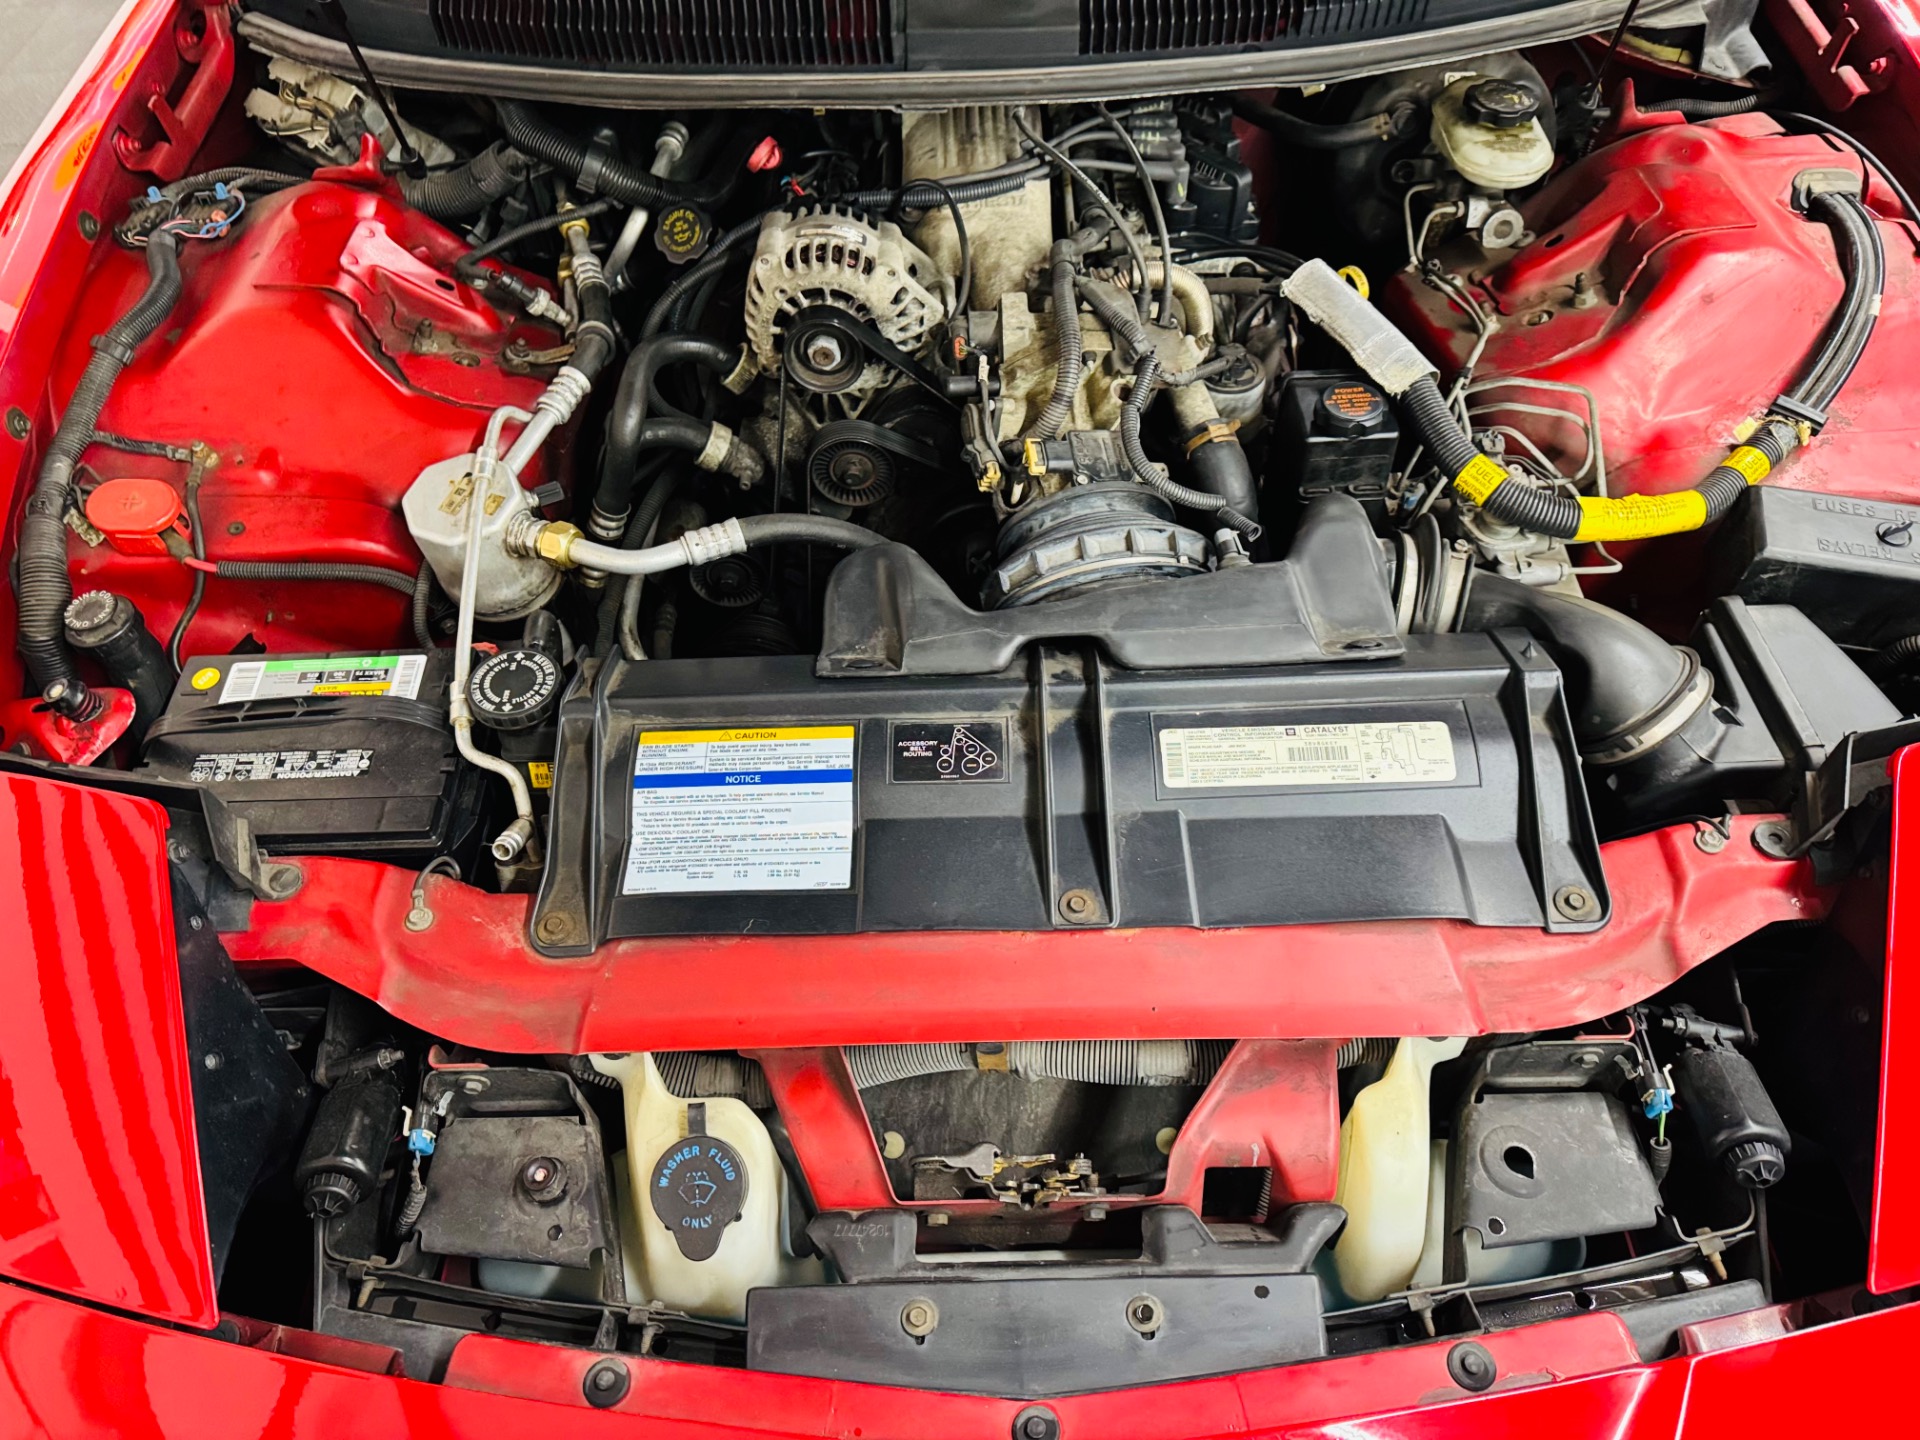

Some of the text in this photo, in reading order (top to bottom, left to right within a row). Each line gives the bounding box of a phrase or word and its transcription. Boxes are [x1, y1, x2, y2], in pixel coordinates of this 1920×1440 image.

[1478, 456, 1503, 477] CAUTION
[1742, 455, 1763, 473] FUEL
[1471, 463, 1495, 486] FUEL
[1459, 476, 1485, 497] CAUTION
[1815, 499, 1875, 517] FUSES
[1820, 539, 1892, 559] RELAYS
[64, 590, 96, 616] ENGINE
[64, 618, 89, 627] ONLY
[524, 654, 553, 709] NEVER OPEN HOT
[512, 690, 535, 704] BOTTLE
[726, 775, 761, 783] NOTICE
[658, 1145, 736, 1188] WASHER FLUID
[682, 1214, 712, 1229] ONLY
[834, 1224, 888, 1236] 10247777
